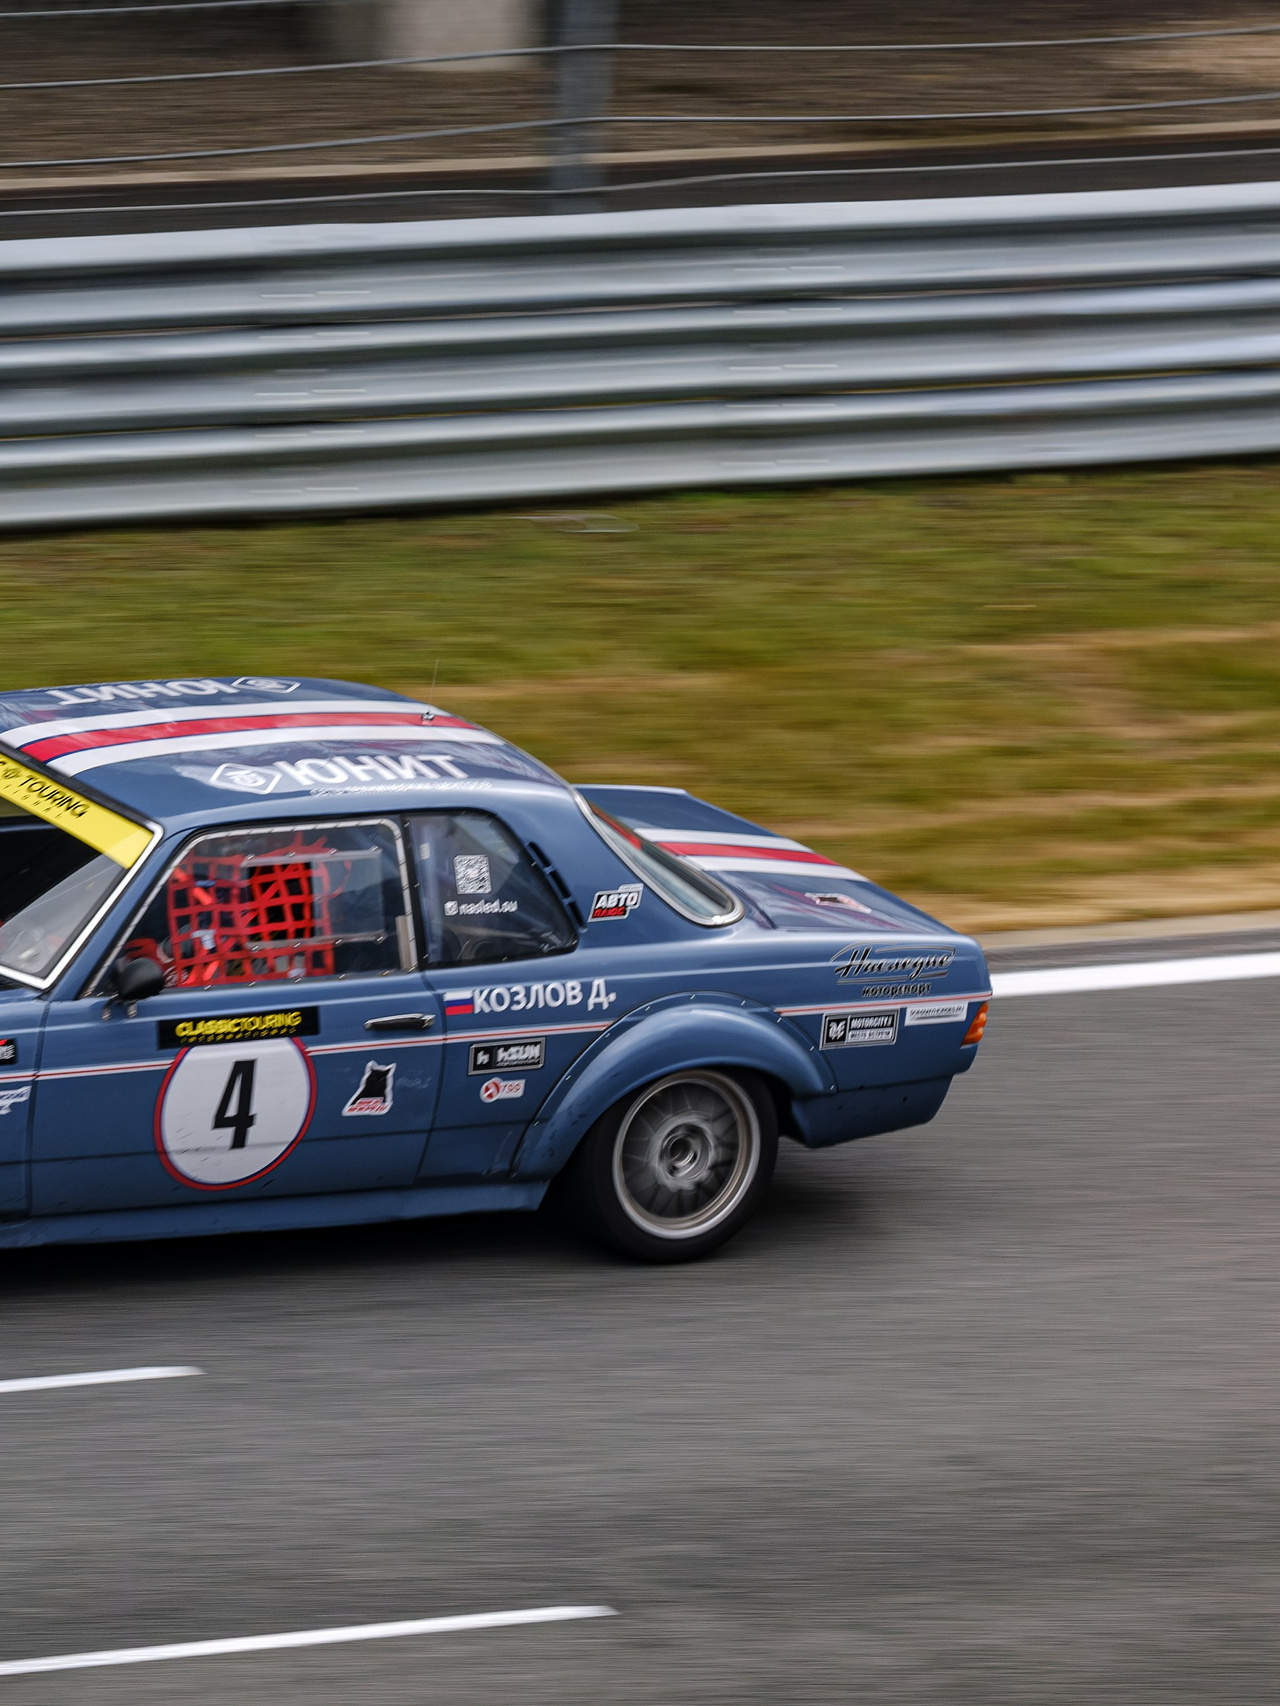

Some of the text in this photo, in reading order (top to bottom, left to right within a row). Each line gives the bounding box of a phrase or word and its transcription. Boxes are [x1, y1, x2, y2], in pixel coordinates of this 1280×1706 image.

[46, 677, 239, 706] ЮНИТ
[272, 754, 470, 786] ЮНИТ
[19, 774, 91, 819] TOURING
[595, 892, 639, 909] АВТО
[473, 978, 617, 1014] КОЗЛОВ Д.
[211, 1057, 258, 1151] 4
